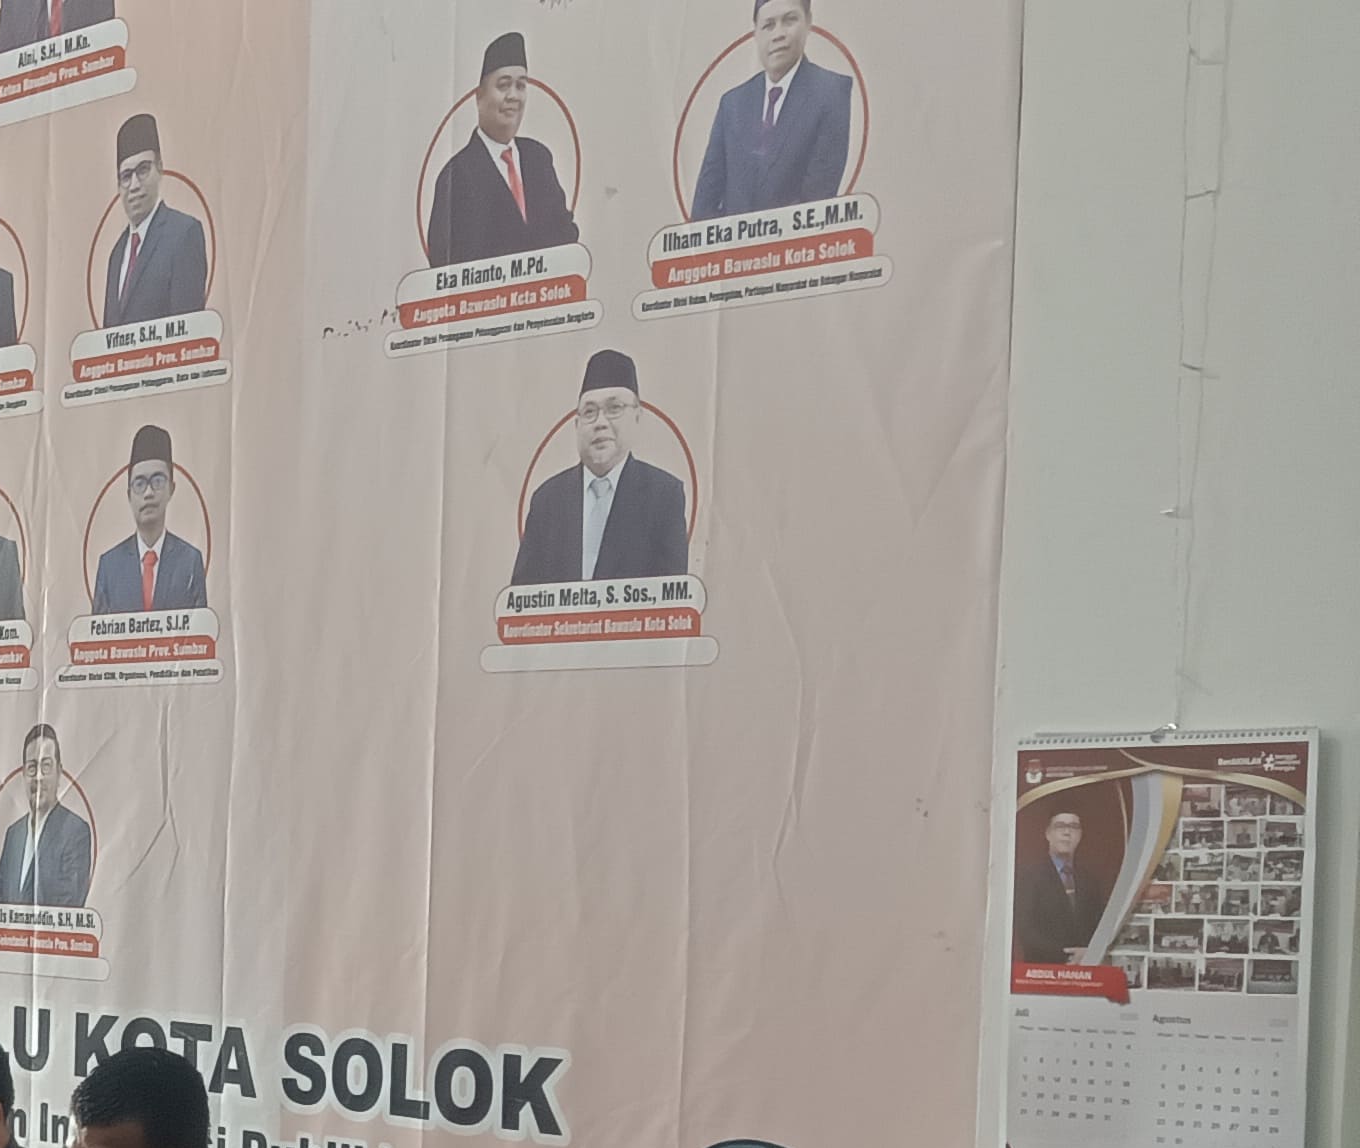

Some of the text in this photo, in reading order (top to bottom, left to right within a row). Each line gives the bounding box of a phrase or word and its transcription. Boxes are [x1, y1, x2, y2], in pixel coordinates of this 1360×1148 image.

[663, 232, 702, 252] Ilham
[706, 226, 732, 246] Eka
[738, 218, 782, 240] Putra,
[436, 256, 548, 290] Eka Rianto, M.Pd.
[668, 239, 856, 284] Anggota Bawaslu Kota Solok
[540, 284, 572, 302] Solok
[166, 320, 188, 338] M.H.
[507, 582, 692, 612] Agustin Melta, S. Sos., MM.
[281, 1031, 564, 1136] SOLOK
